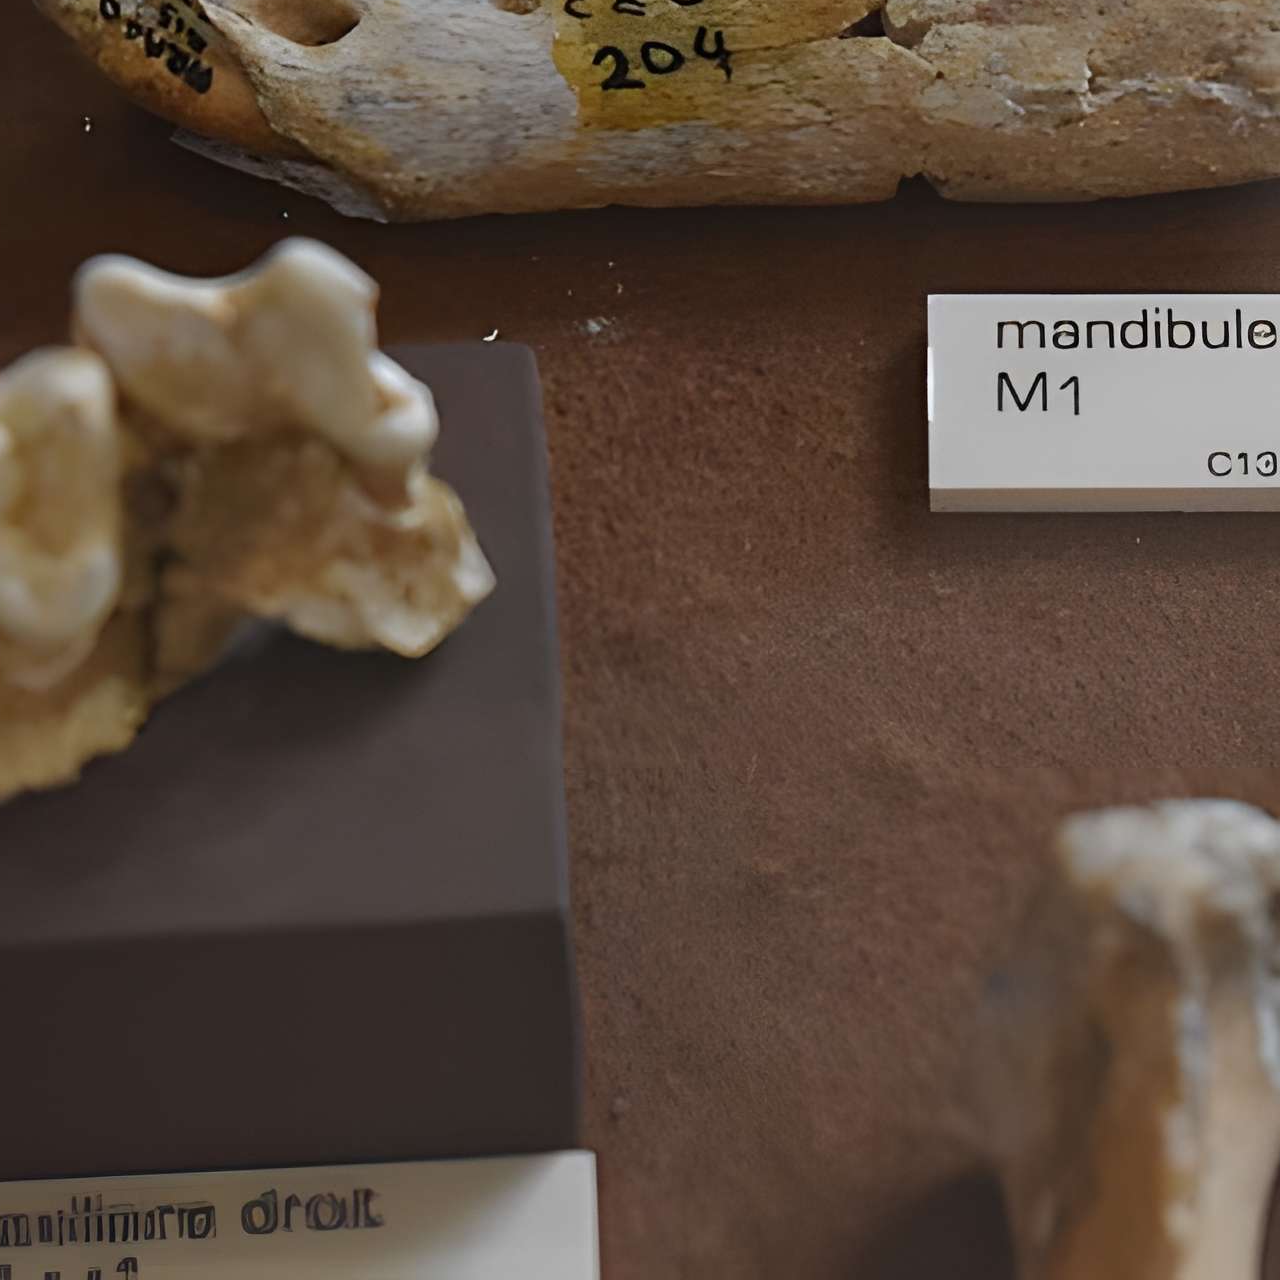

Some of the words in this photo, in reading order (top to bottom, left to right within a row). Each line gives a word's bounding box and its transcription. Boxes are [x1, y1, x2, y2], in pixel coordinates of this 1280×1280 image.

[591, 25, 734, 92] 204
[996, 306, 1278, 350] mandibule
[996, 370, 1082, 417] M1
